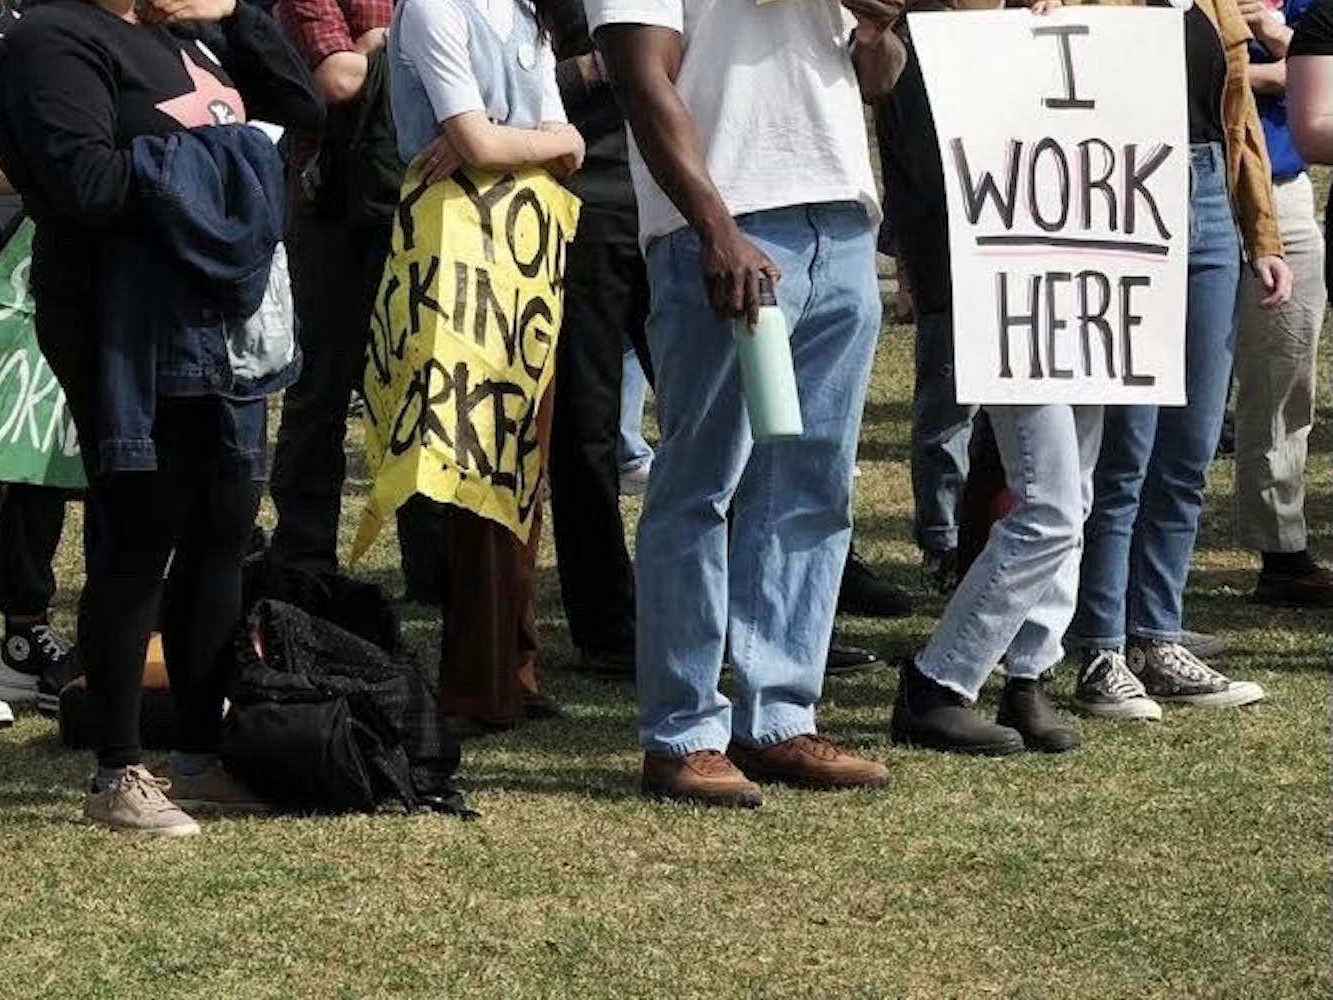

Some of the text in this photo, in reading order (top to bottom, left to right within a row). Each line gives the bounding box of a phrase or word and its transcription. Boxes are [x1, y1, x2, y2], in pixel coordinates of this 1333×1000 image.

[1031, 24, 1096, 110] I
[949, 136, 1173, 240] WORK
[369, 255, 554, 384] UCKING
[994, 269, 1156, 387] HERE
